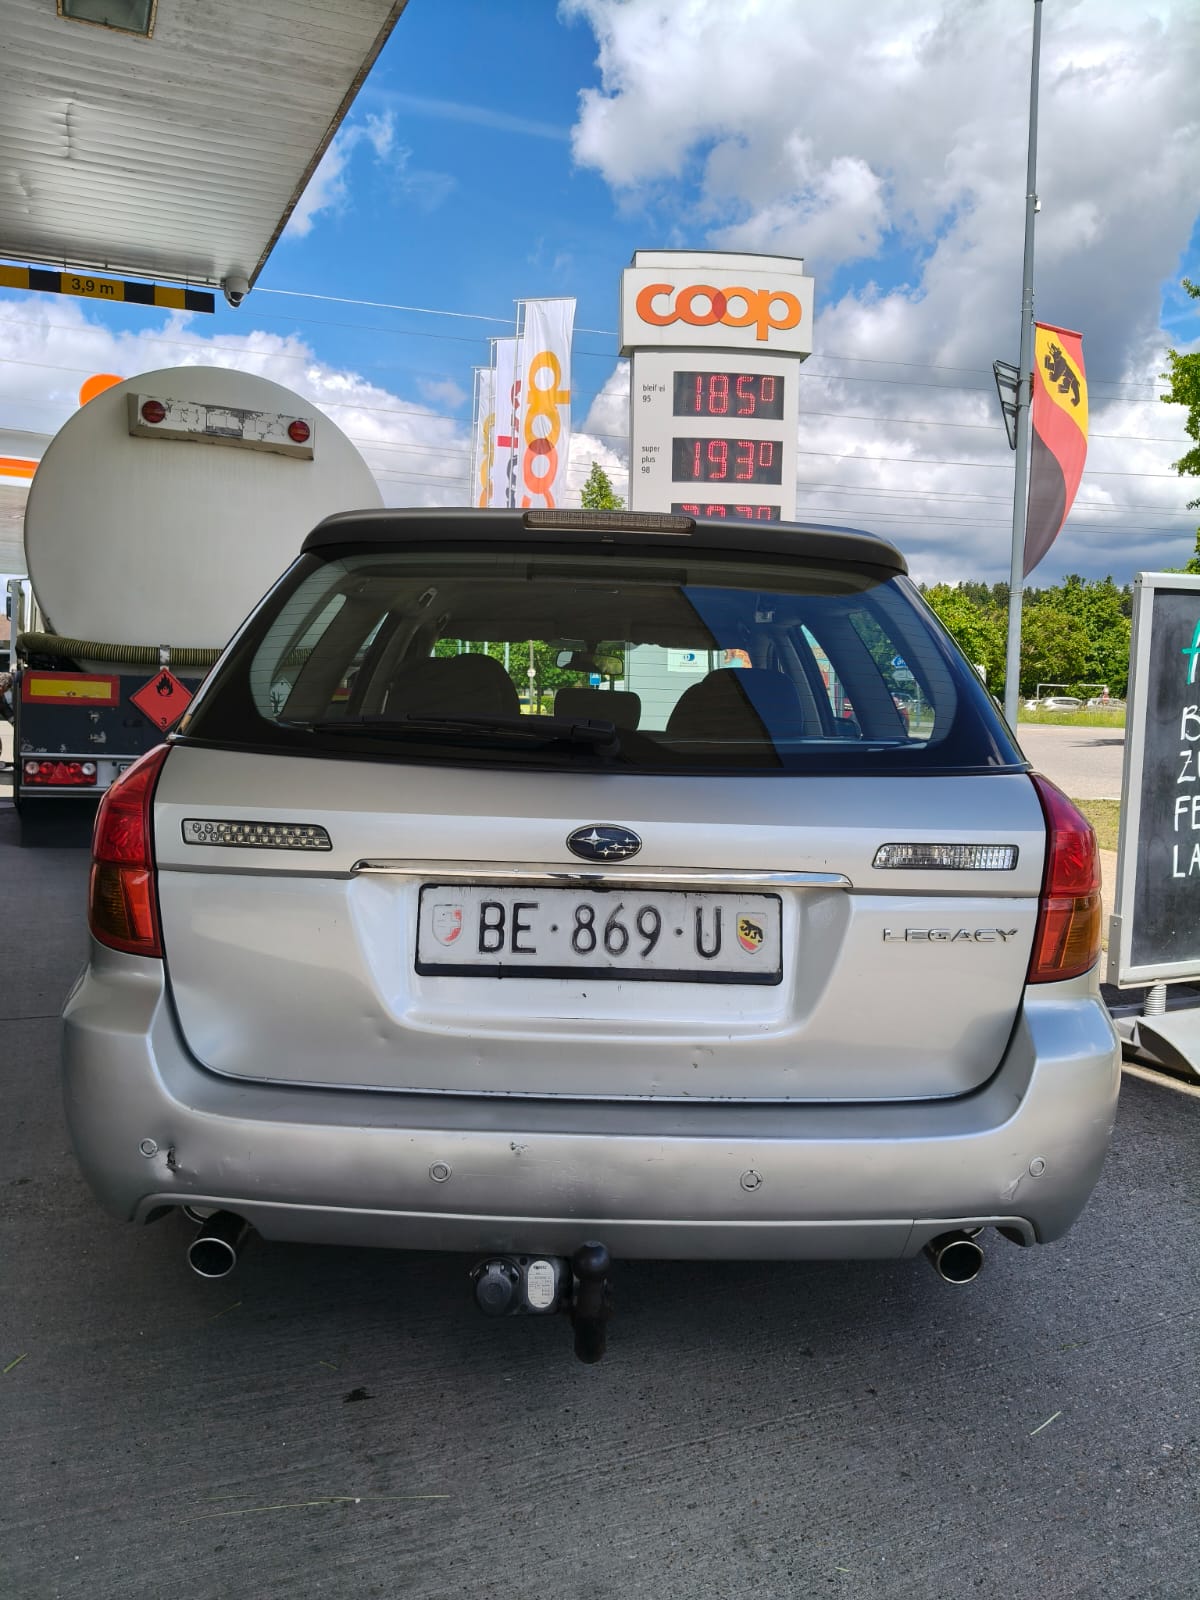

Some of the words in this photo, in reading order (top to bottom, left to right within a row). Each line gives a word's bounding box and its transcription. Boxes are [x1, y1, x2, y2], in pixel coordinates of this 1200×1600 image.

[71, 278, 95, 293] 3,9
[100, 284, 114, 295] m
[636, 283, 802, 341] coop
[642, 394, 652, 403] 95
[641, 445, 661, 454] super
[641, 455, 656, 465] plus
[641, 465, 651, 474] 98
[159, 717, 168, 726] 3
[882, 927, 1019, 943] LEGACY
